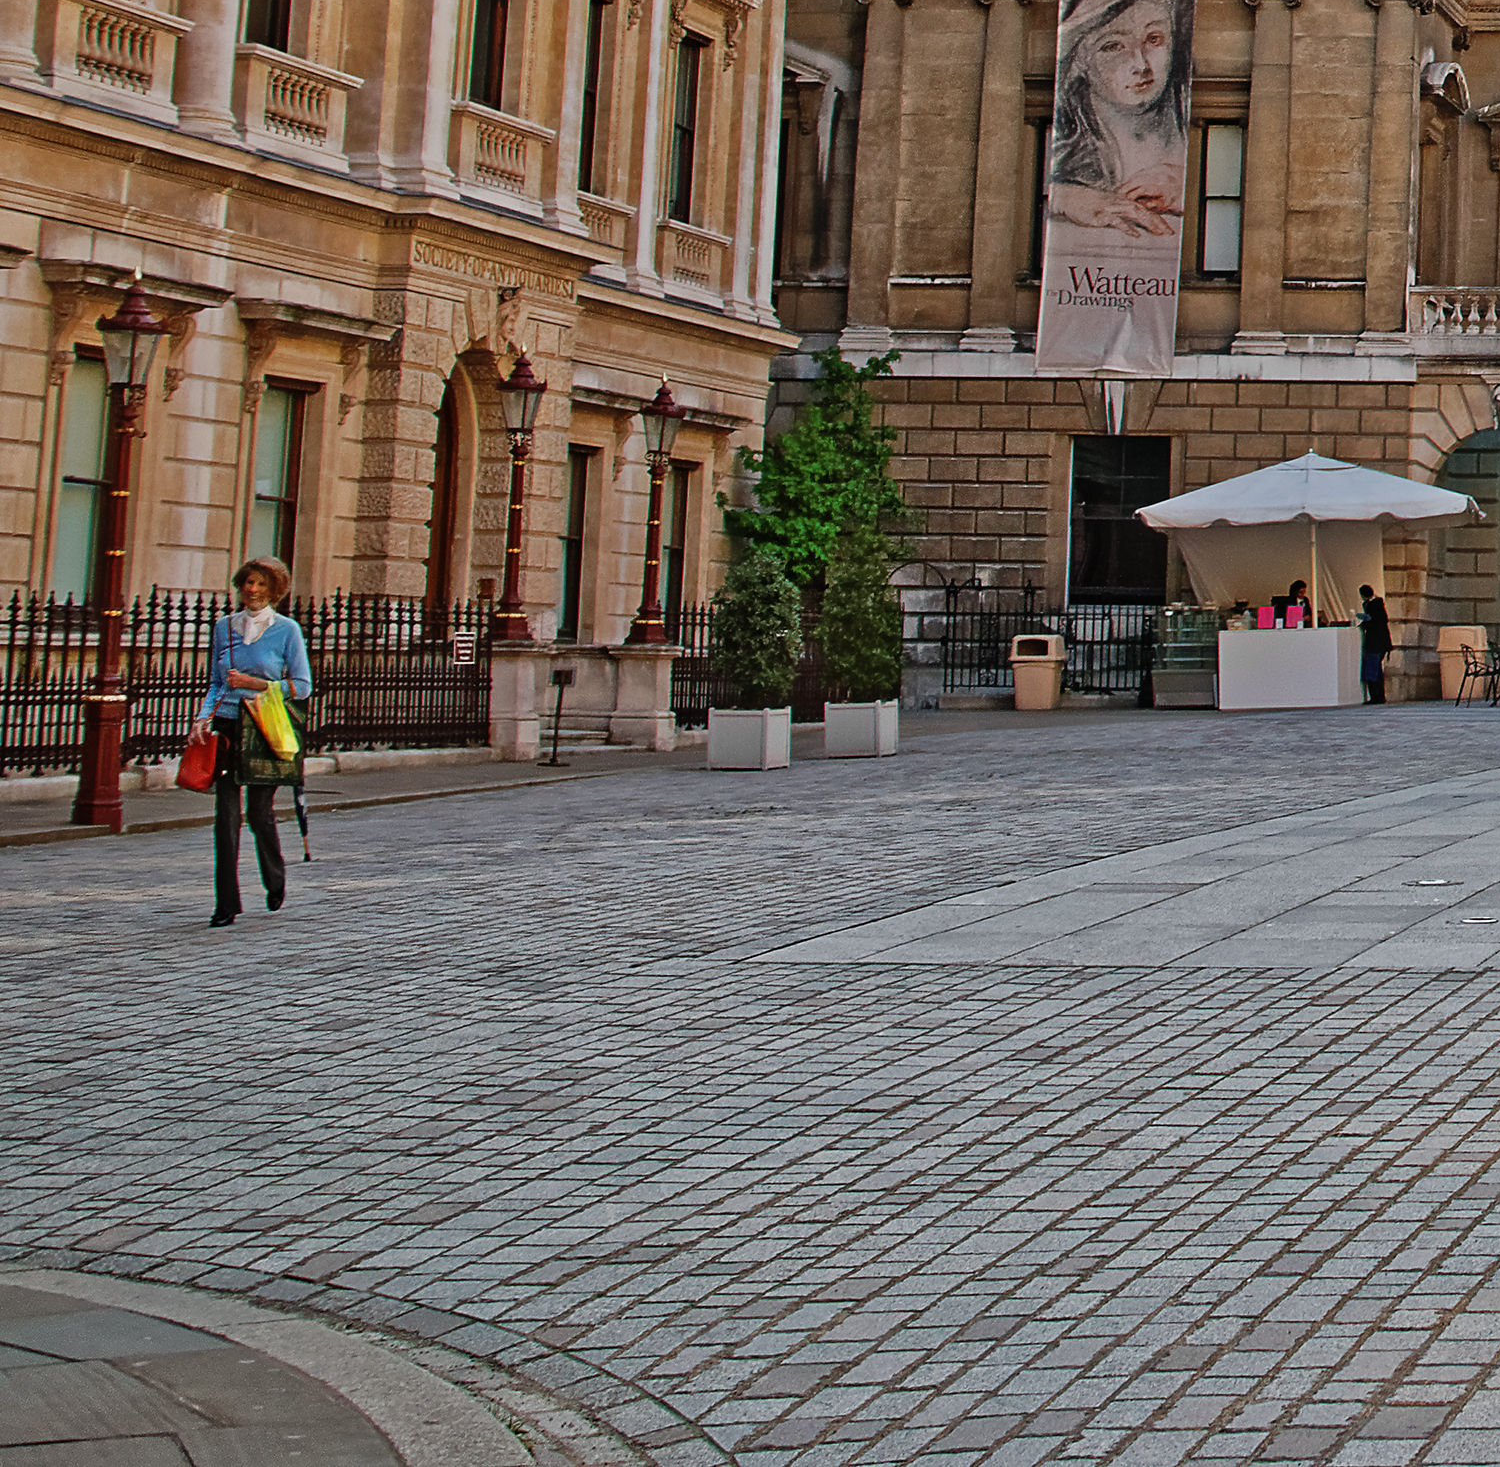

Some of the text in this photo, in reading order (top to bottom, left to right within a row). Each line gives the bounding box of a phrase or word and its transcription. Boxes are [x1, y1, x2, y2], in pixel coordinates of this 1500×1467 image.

[414, 242, 469, 274] SOCIETY
[1068, 265, 1176, 297] Watteau
[1057, 289, 1135, 312] Drawings
